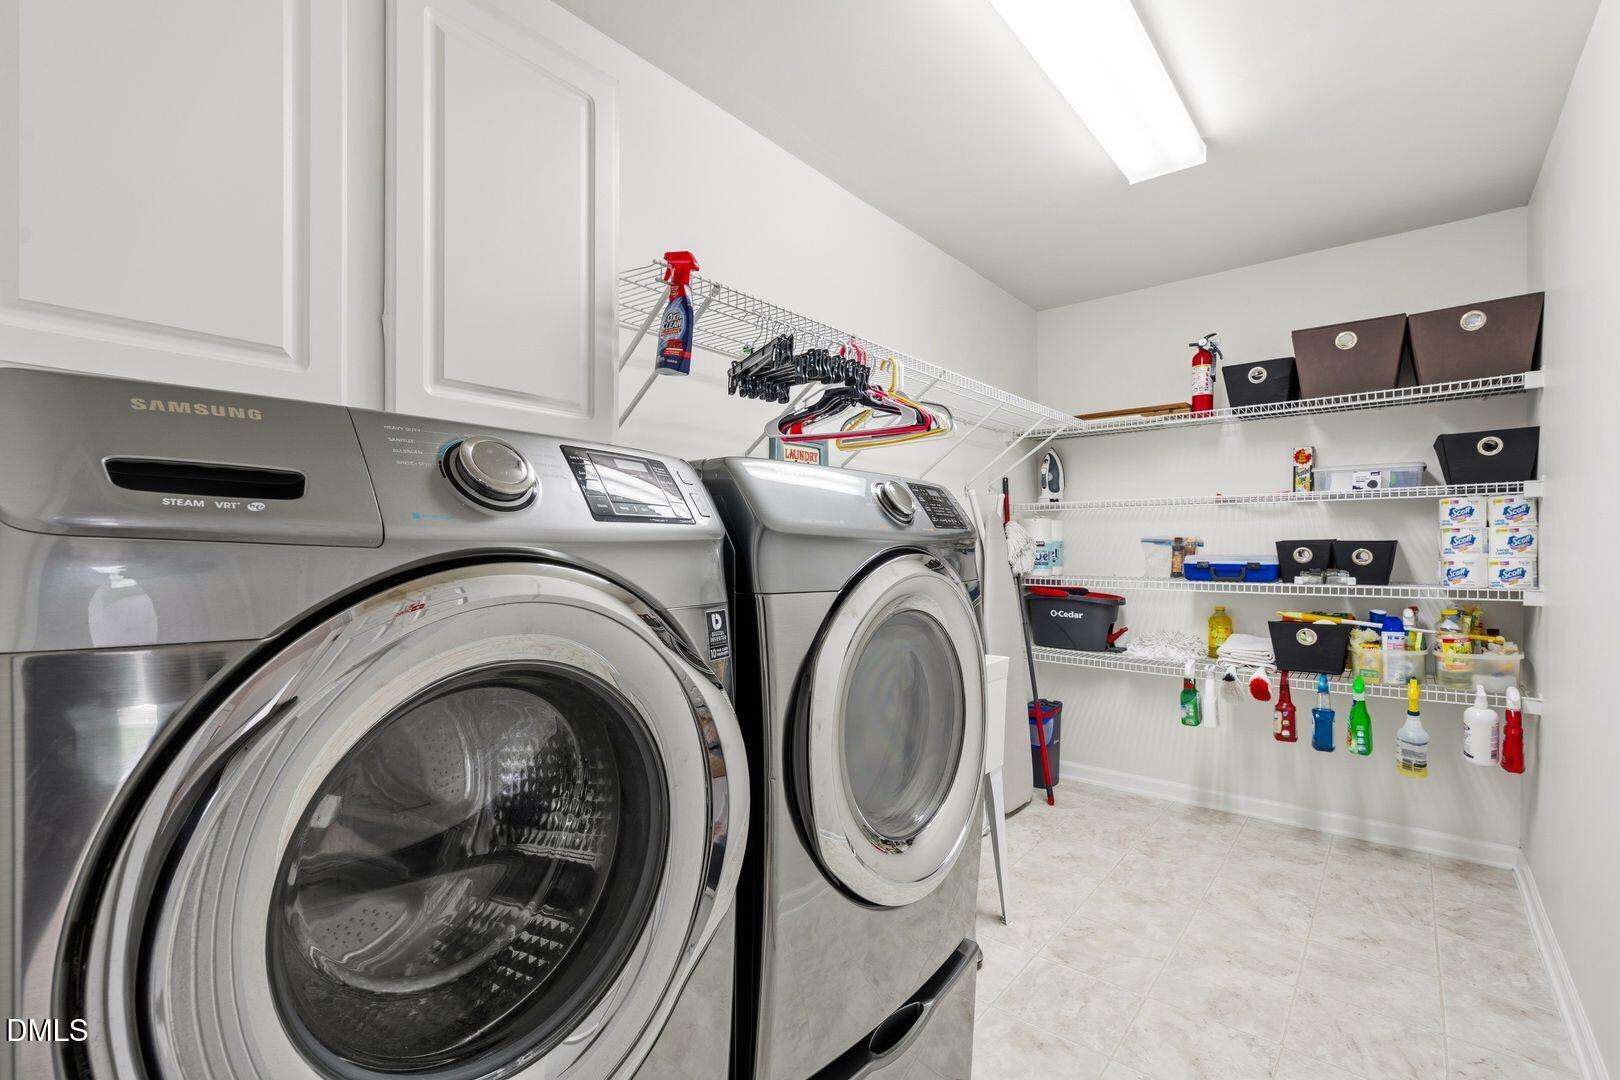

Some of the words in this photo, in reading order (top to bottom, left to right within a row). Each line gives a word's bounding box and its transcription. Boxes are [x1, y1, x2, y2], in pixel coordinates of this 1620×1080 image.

[663, 319, 682, 328] CLEAN
[130, 398, 262, 420] SAMSUNG
[784, 448, 818, 463] LAUNDRY
[162, 497, 205, 507] STEAM
[1450, 506, 1472, 518] Scott
[1506, 505, 1528, 517] Scott
[1452, 535, 1473, 547] Scott
[1511, 535, 1532, 547] Scott
[1449, 568, 1467, 578] Scott
[1501, 567, 1523, 579] Scott
[1050, 609, 1083, 618] O-Cedar
